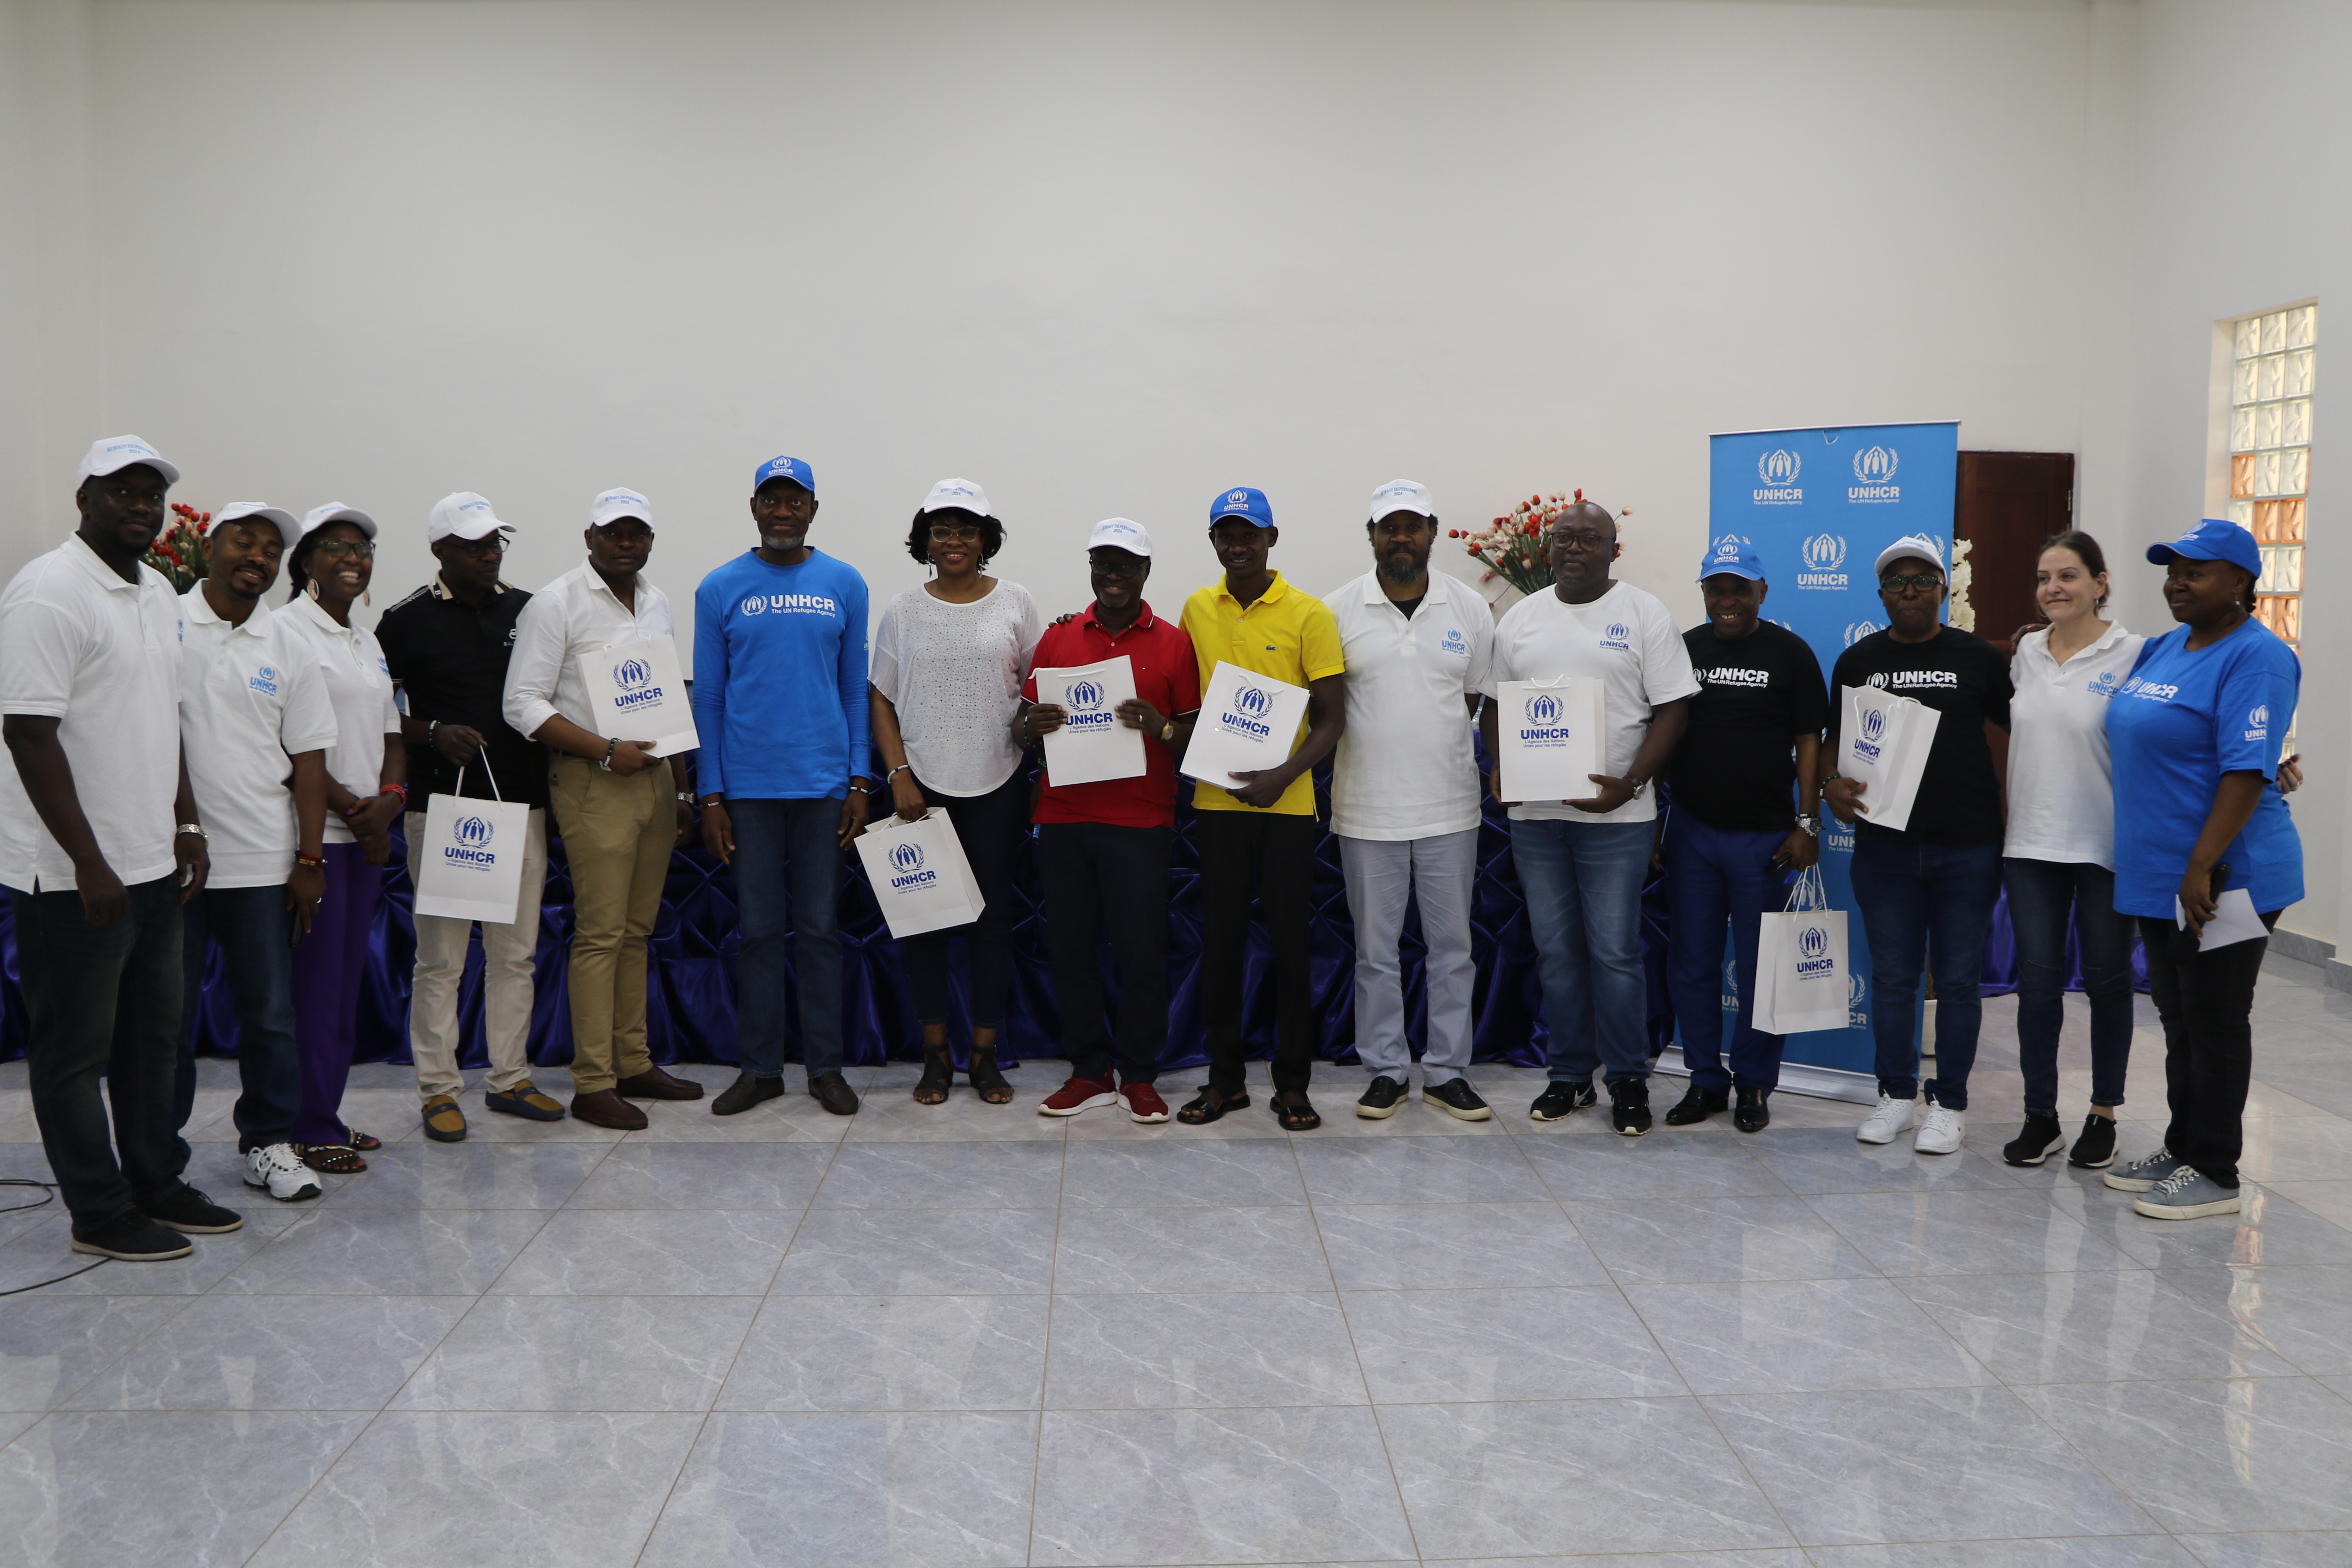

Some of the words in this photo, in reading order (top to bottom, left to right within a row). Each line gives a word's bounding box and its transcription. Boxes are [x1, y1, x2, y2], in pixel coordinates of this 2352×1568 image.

[1754, 489, 1803, 500] UNHCR
[1848, 486, 1900, 498] UNHCR
[1798, 574, 1848, 585] UNHCR
[771, 594, 835, 612] UNHCR
[817, 609, 836, 618] Agency
[1442, 640, 1465, 652] UNHCR
[1600, 640, 1629, 649] UNHCR
[1708, 668, 1769, 683] UNHCR
[1893, 671, 1957, 684] UNHCR
[251, 676, 276, 693] UNHCR
[2089, 681, 2119, 695] UNHCR
[615, 688, 663, 707] UNHCR
[1222, 713, 1270, 736] UNHCR
[1224, 723, 1241, 732] L'Agence
[1521, 729, 1569, 739] UNHCR
[2245, 729, 2266, 738] UNH
[1855, 739, 1880, 758] UNHCR
[1828, 835, 1855, 847] UNH
[445, 847, 495, 864] UNHCR
[891, 870, 936, 888] UNHCR
[1797, 959, 1833, 973] UNHCR
